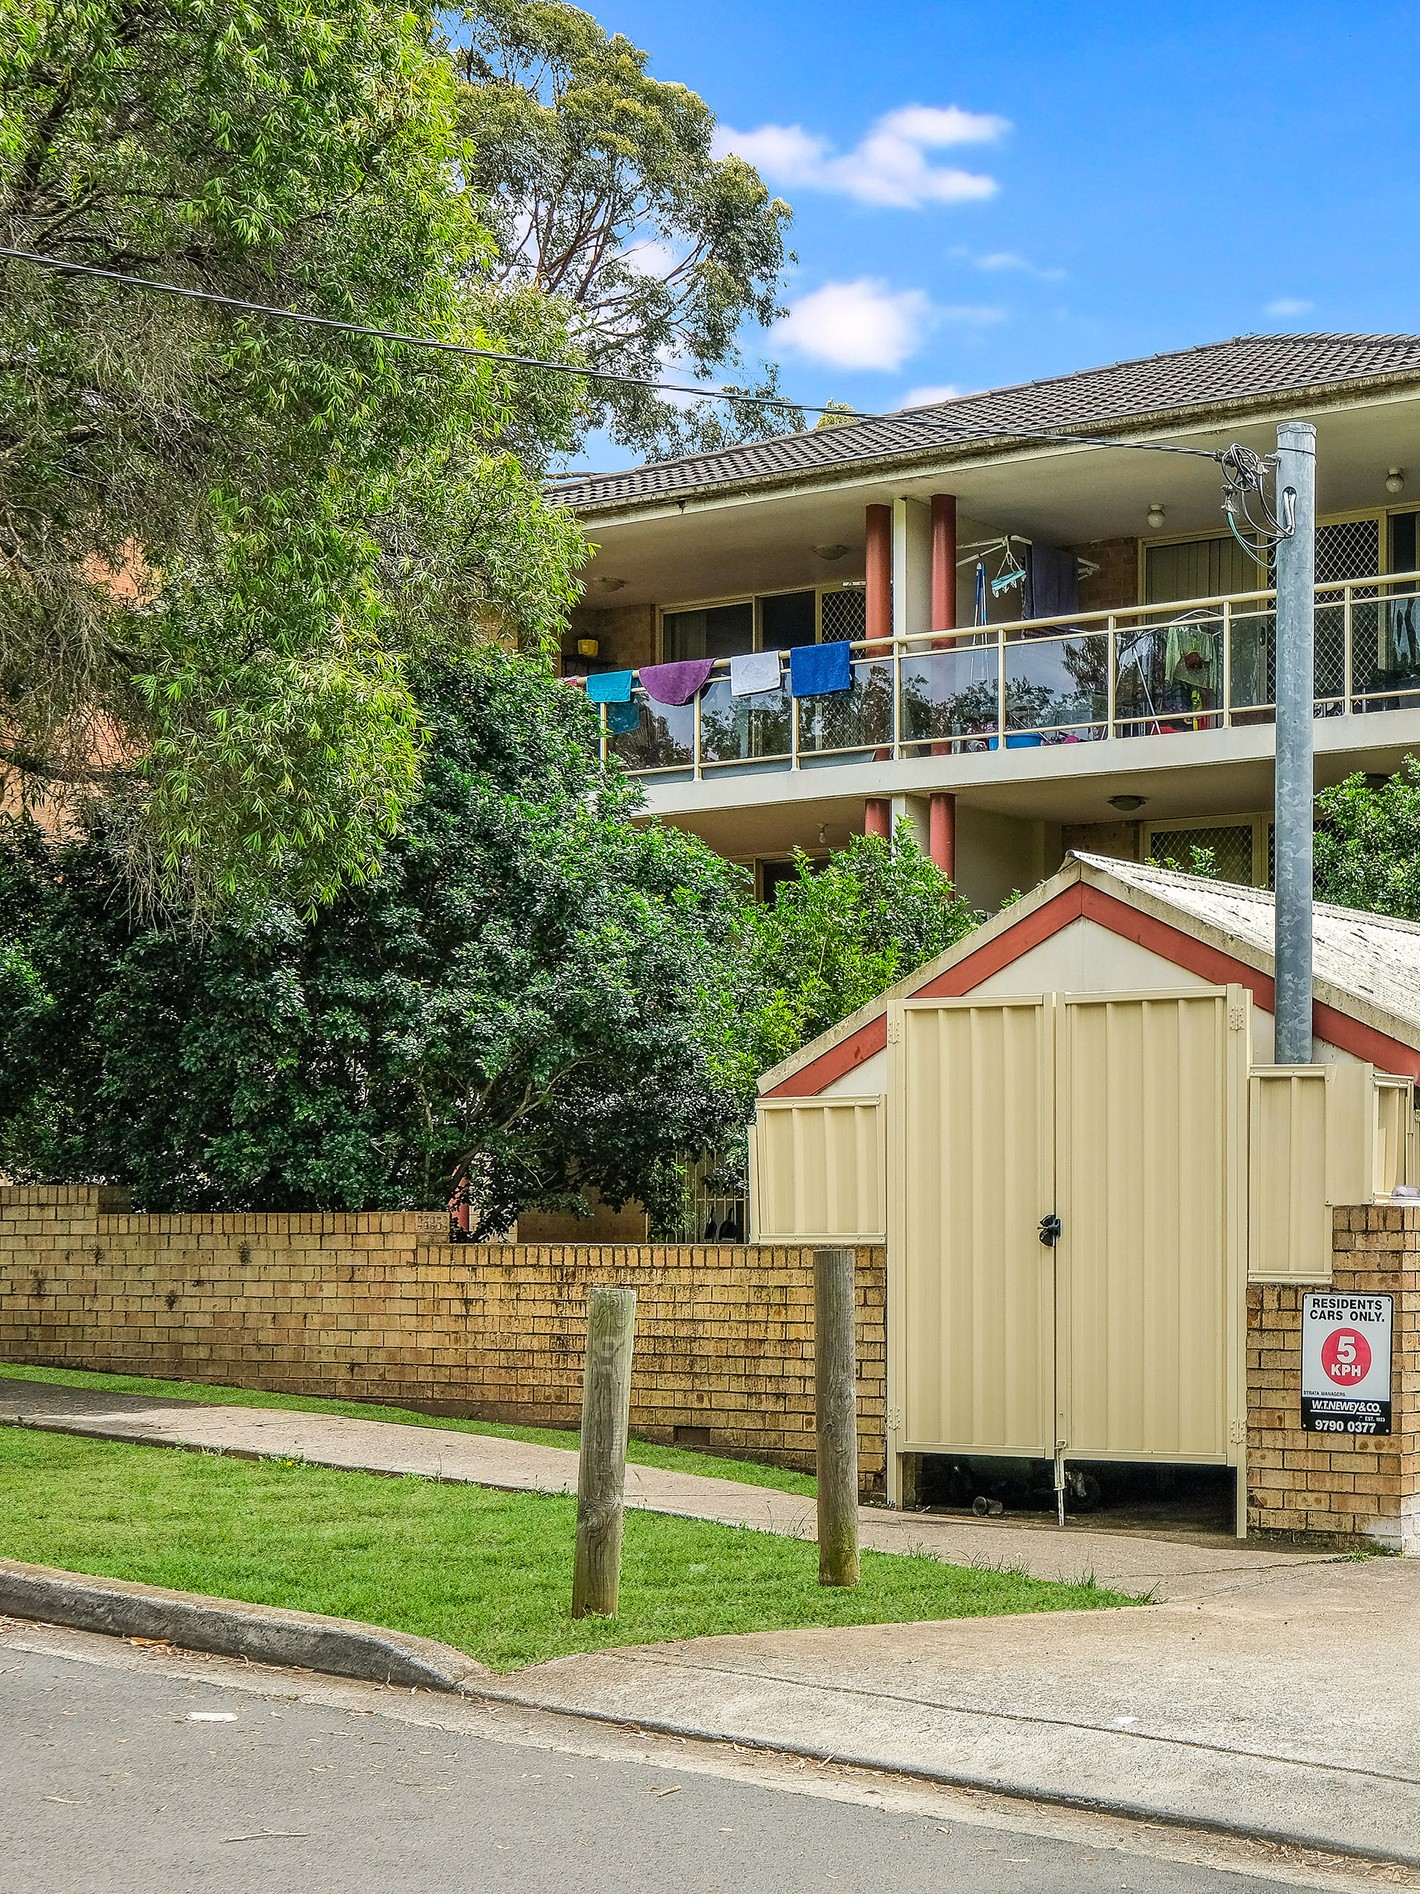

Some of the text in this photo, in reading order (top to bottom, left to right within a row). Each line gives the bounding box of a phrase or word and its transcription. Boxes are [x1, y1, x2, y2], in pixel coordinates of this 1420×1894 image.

[1312, 1298, 1382, 1310] RESIDENTS
[1310, 1310, 1385, 1322] CARS ONLY.
[1336, 1336, 1356, 1363] 5
[1331, 1364, 1361, 1376] KPH
[1315, 1420, 1376, 1433] 9790 0377
